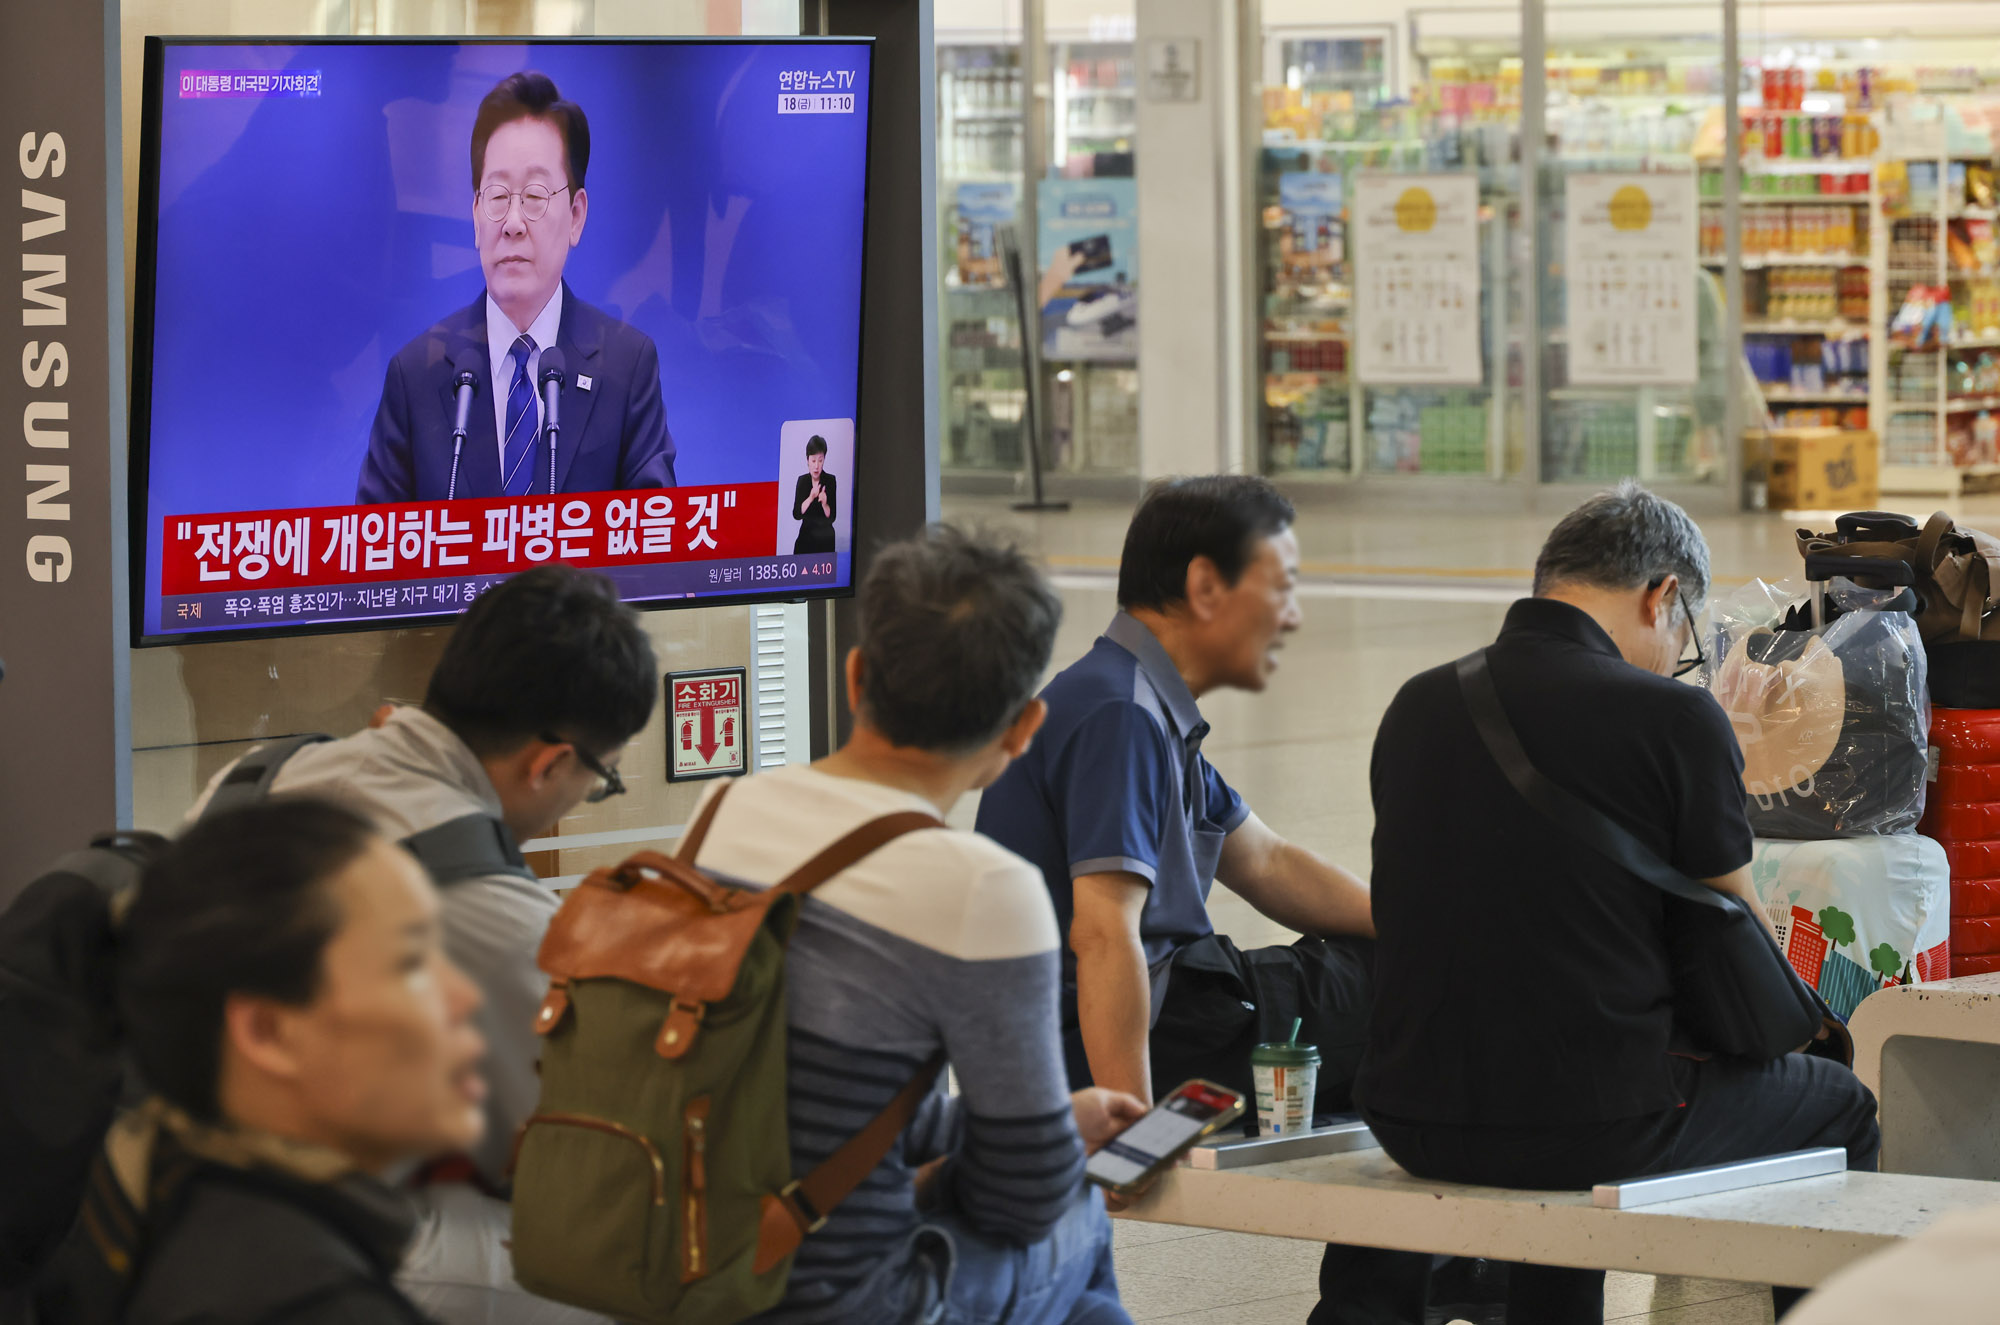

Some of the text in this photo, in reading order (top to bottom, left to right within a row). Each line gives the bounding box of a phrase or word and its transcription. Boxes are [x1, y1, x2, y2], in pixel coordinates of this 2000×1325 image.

[182, 75, 194, 92] 이
[196, 75, 232, 92] 대통령
[234, 75, 270, 92] 대국민
[779, 70, 856, 90] 연합뉴스TV
[784, 97, 851, 110] 18(금) 11:10
[19, 132, 72, 583] SAMSUNG
[177, 490, 737, 582] "전쟁에 개입하는 파병은 없을 것"
[708, 562, 832, 583] 원/달러 1385.60 4.10
[401, 586, 429, 606] 지구
[432, 583, 459, 603] 대기
[462, 582, 477, 602] 중
[176, 602, 202, 620] 국제
[678, 680, 736, 702] 소화기
[693, 699, 737, 708] EXTINGUISHER
